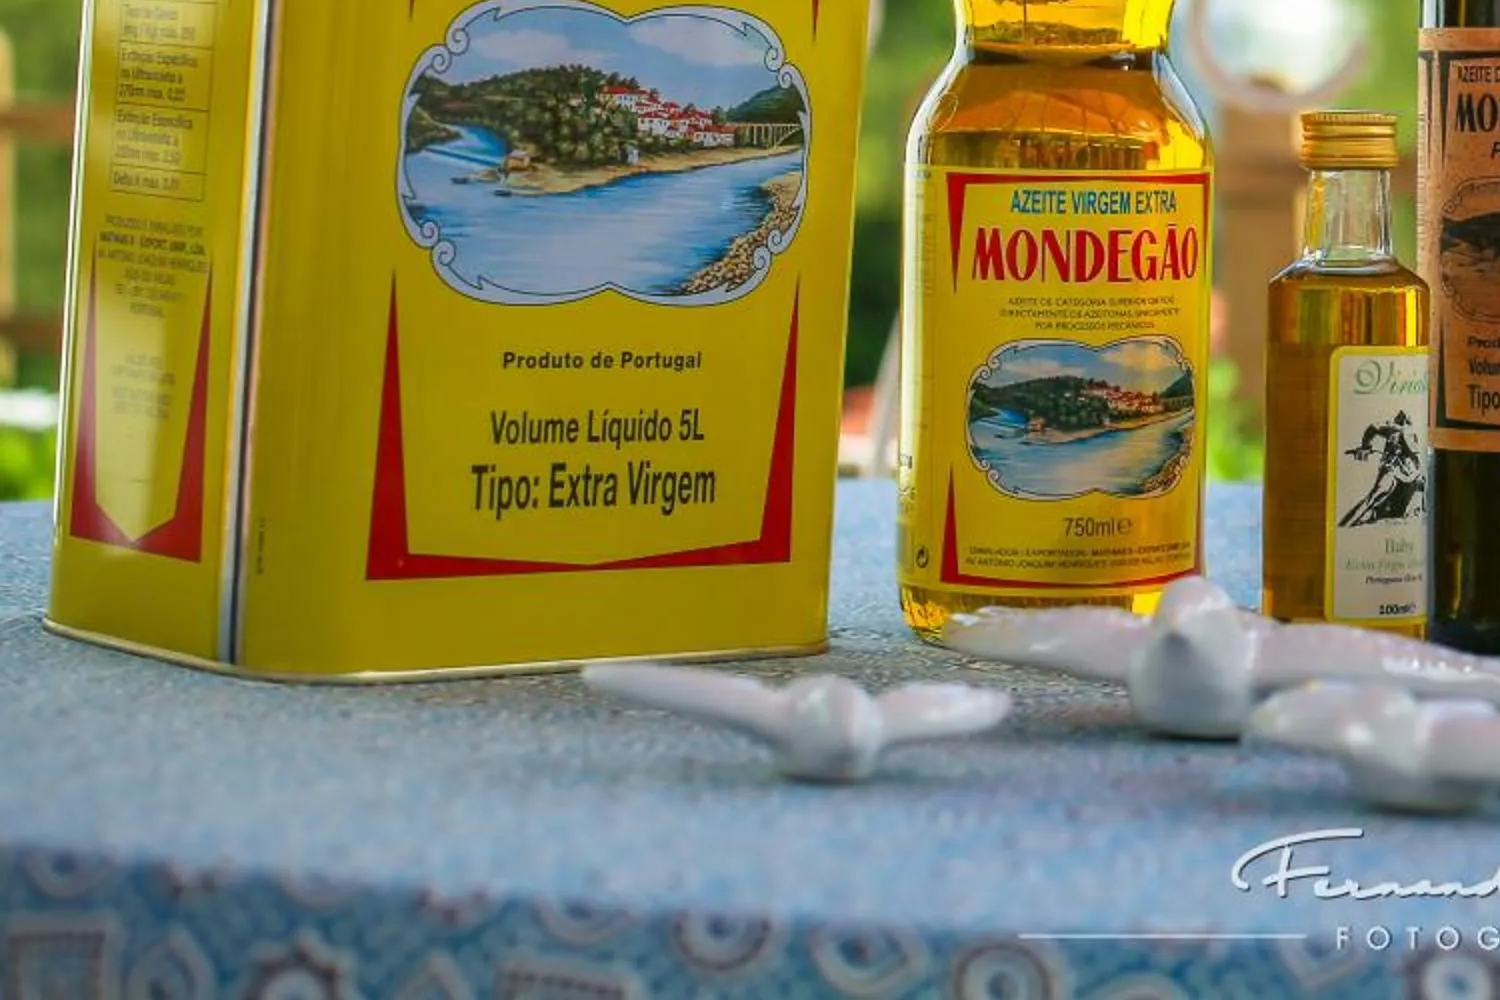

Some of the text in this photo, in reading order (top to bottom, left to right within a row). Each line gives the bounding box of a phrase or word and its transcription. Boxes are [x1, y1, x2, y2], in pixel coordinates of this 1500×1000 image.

[1457, 66, 1491, 83] AZEITE
[1010, 189, 1177, 215] AZEITE VIRGEM EXTRA
[971, 223, 1199, 283] MONDEGÃO
[502, 350, 702, 372] Produto de Portugal
[490, 408, 705, 450] Volume Líquido 5L
[471, 460, 717, 521] Tipo: Extra Virgem
